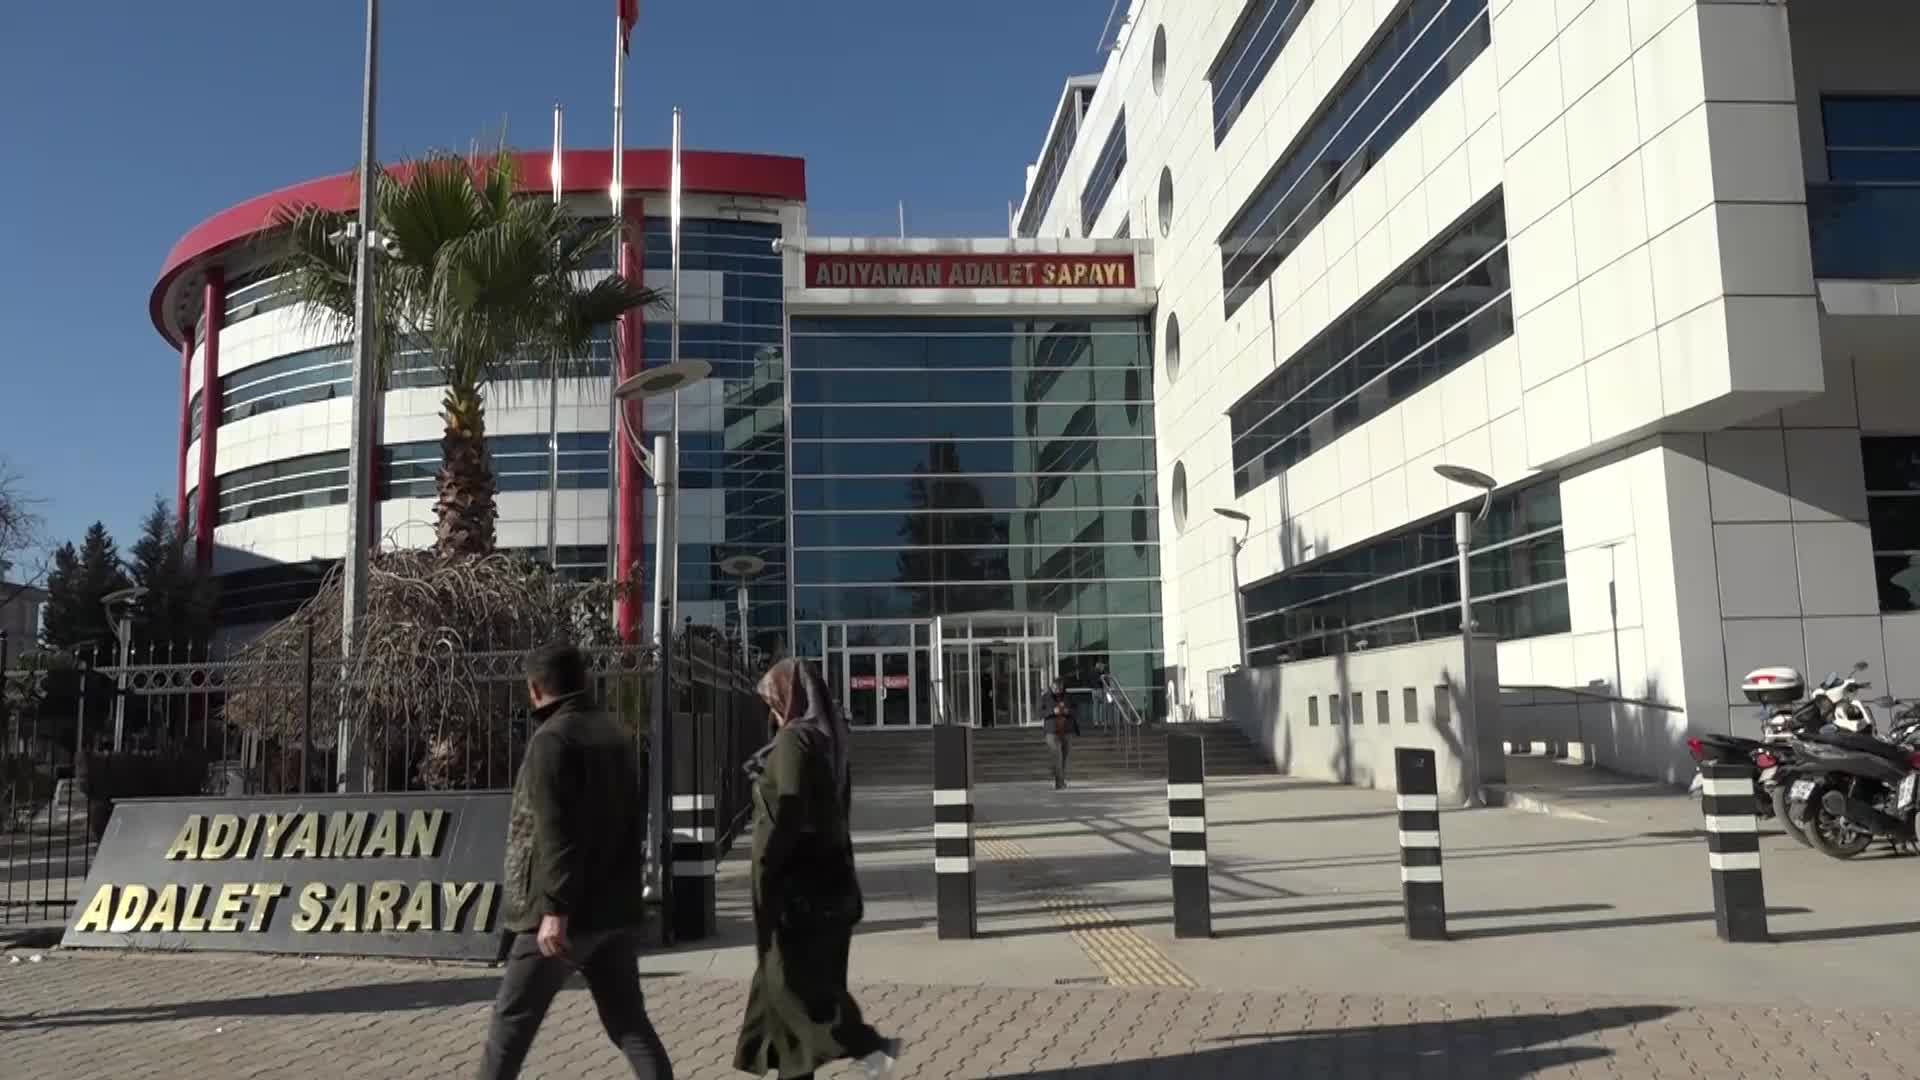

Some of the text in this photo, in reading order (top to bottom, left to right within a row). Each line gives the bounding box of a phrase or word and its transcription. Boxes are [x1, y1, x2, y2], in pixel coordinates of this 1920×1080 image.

[816, 262, 940, 286] ADIYAMAN
[948, 262, 1034, 286] ADALET
[165, 809, 444, 860] ADIYAMAN
[75, 880, 498, 932] ADALET SARAYI
